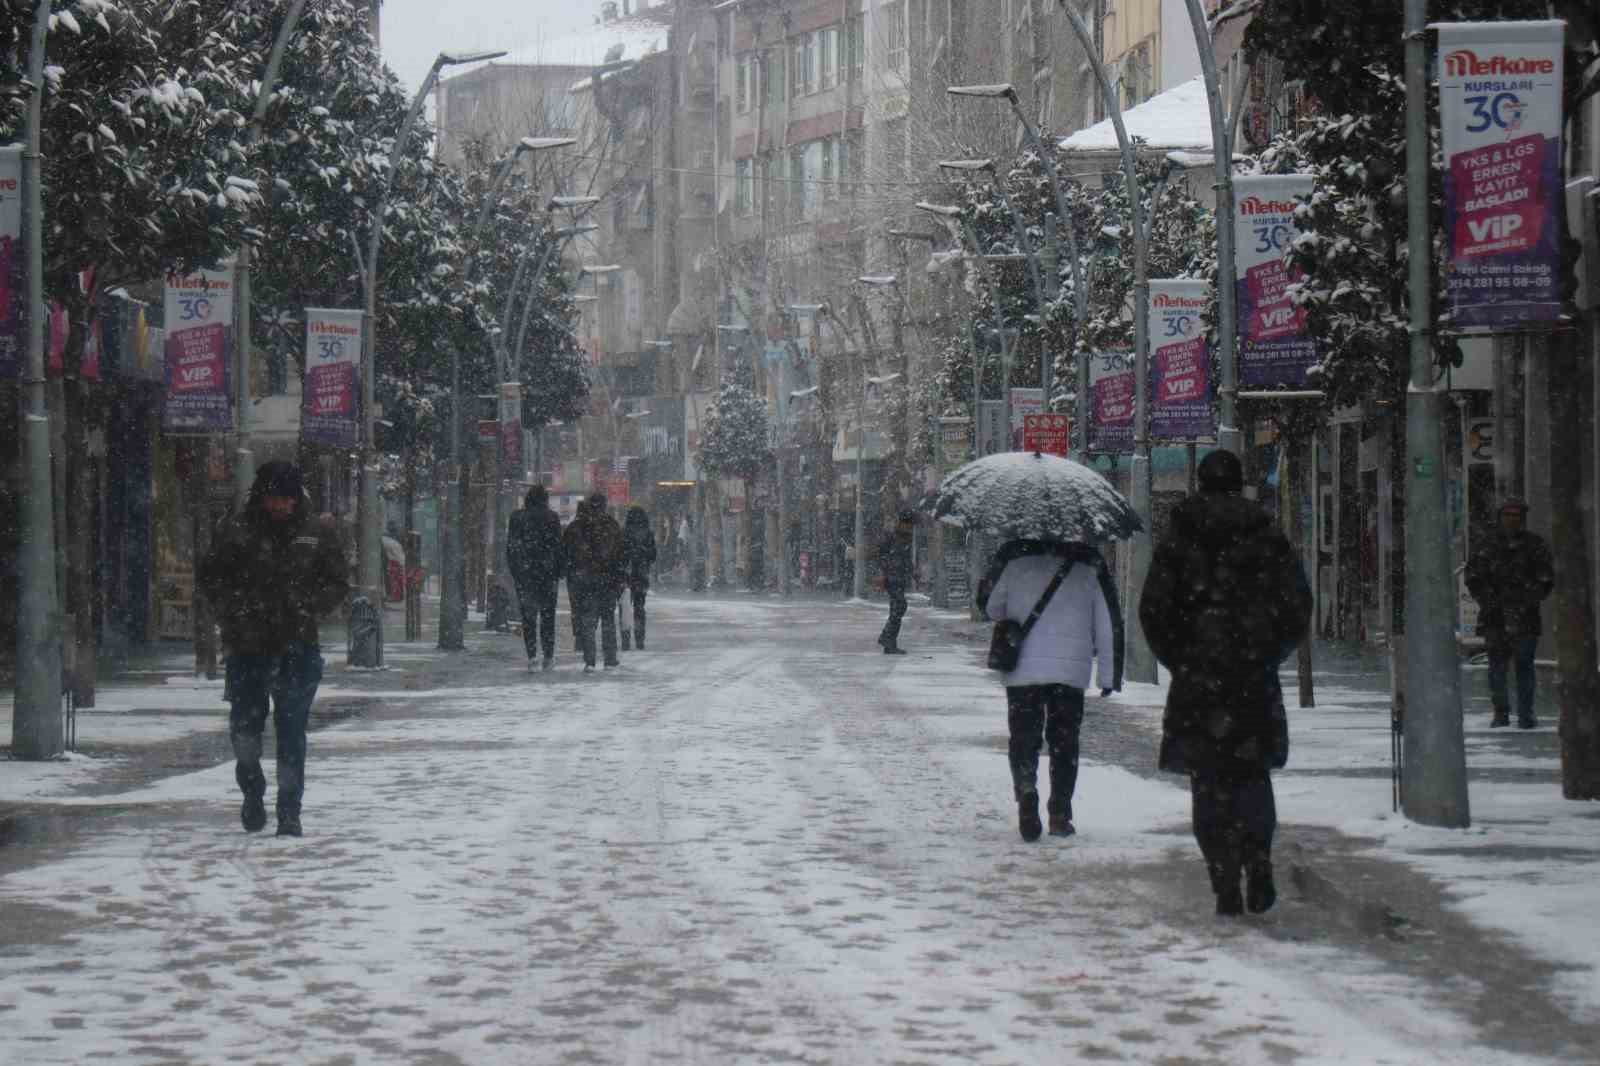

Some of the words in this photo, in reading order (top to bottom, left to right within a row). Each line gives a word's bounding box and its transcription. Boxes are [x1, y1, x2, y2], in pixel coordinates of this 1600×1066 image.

[1464, 80, 1533, 92] KURSLARI
[1462, 153, 1488, 169] YKS
[1505, 143, 1536, 159] LGS
[1472, 160, 1521, 181] ERKEN
[1474, 175, 1518, 195] KAYIT
